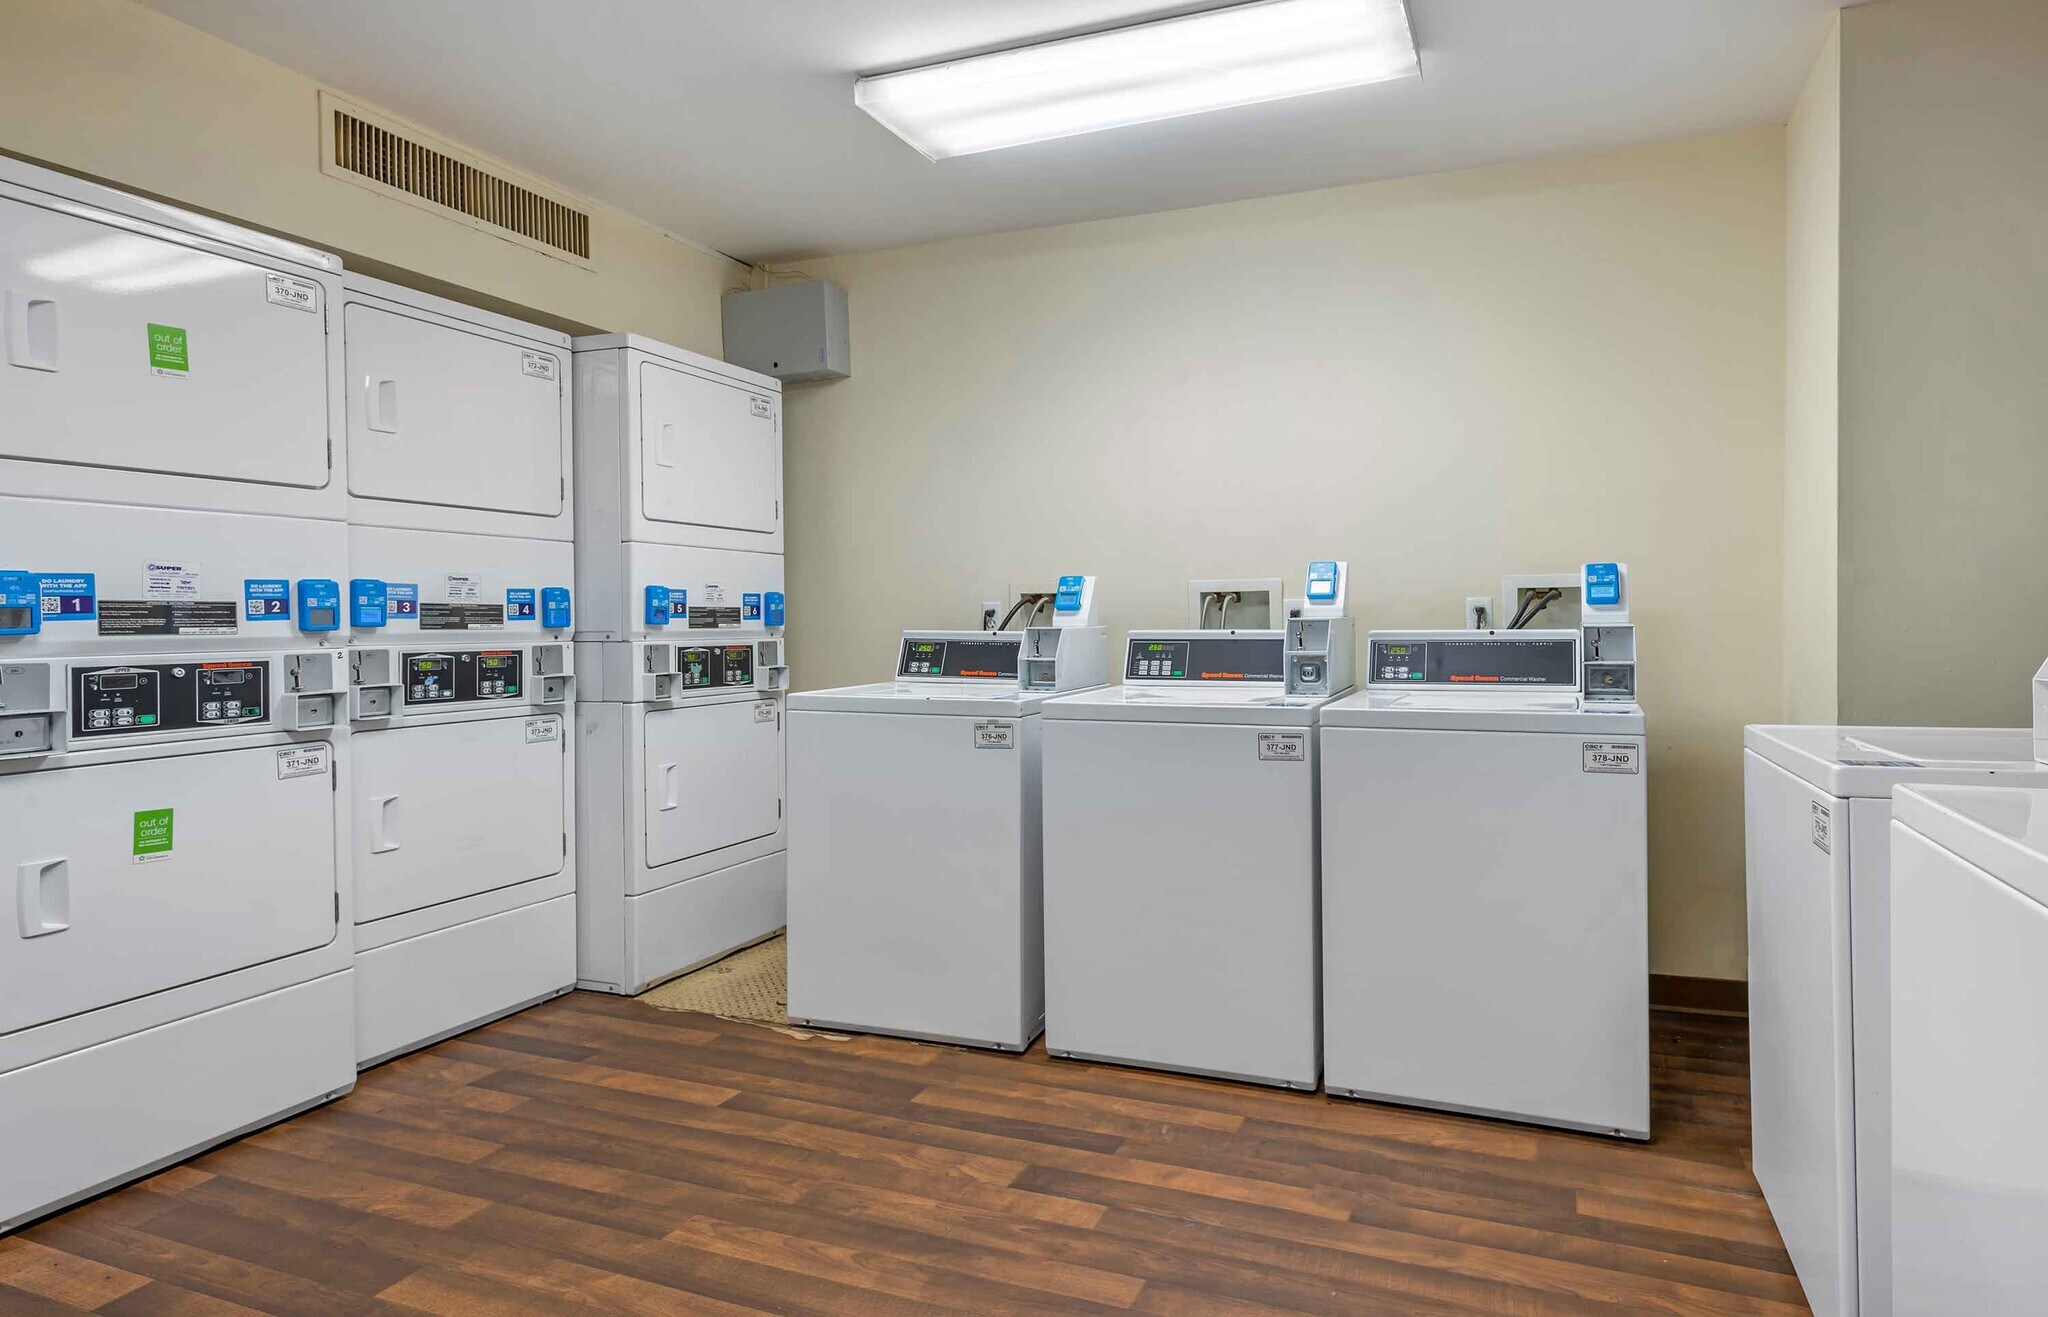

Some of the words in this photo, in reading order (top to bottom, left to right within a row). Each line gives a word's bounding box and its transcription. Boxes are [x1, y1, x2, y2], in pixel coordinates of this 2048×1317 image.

[275, 286, 309, 301] 370-JND
[154, 334, 170, 343] out
[173, 335, 183, 344] of
[156, 342, 183, 354] order
[72, 598, 81, 612] 1
[271, 601, 281, 613] 2
[402, 602, 411, 612] 3
[523, 605, 530, 614] 4
[677, 604, 683, 613] 5
[752, 607, 758, 615] 6
[337, 652, 343, 660] 2
[203, 662, 227, 670] Speed
[286, 757, 320, 768] 371-JND
[1592, 754, 1630, 762] 378-JND
[139, 819, 156, 828] out
[159, 817, 169, 826] of
[141, 827, 168, 837] order
